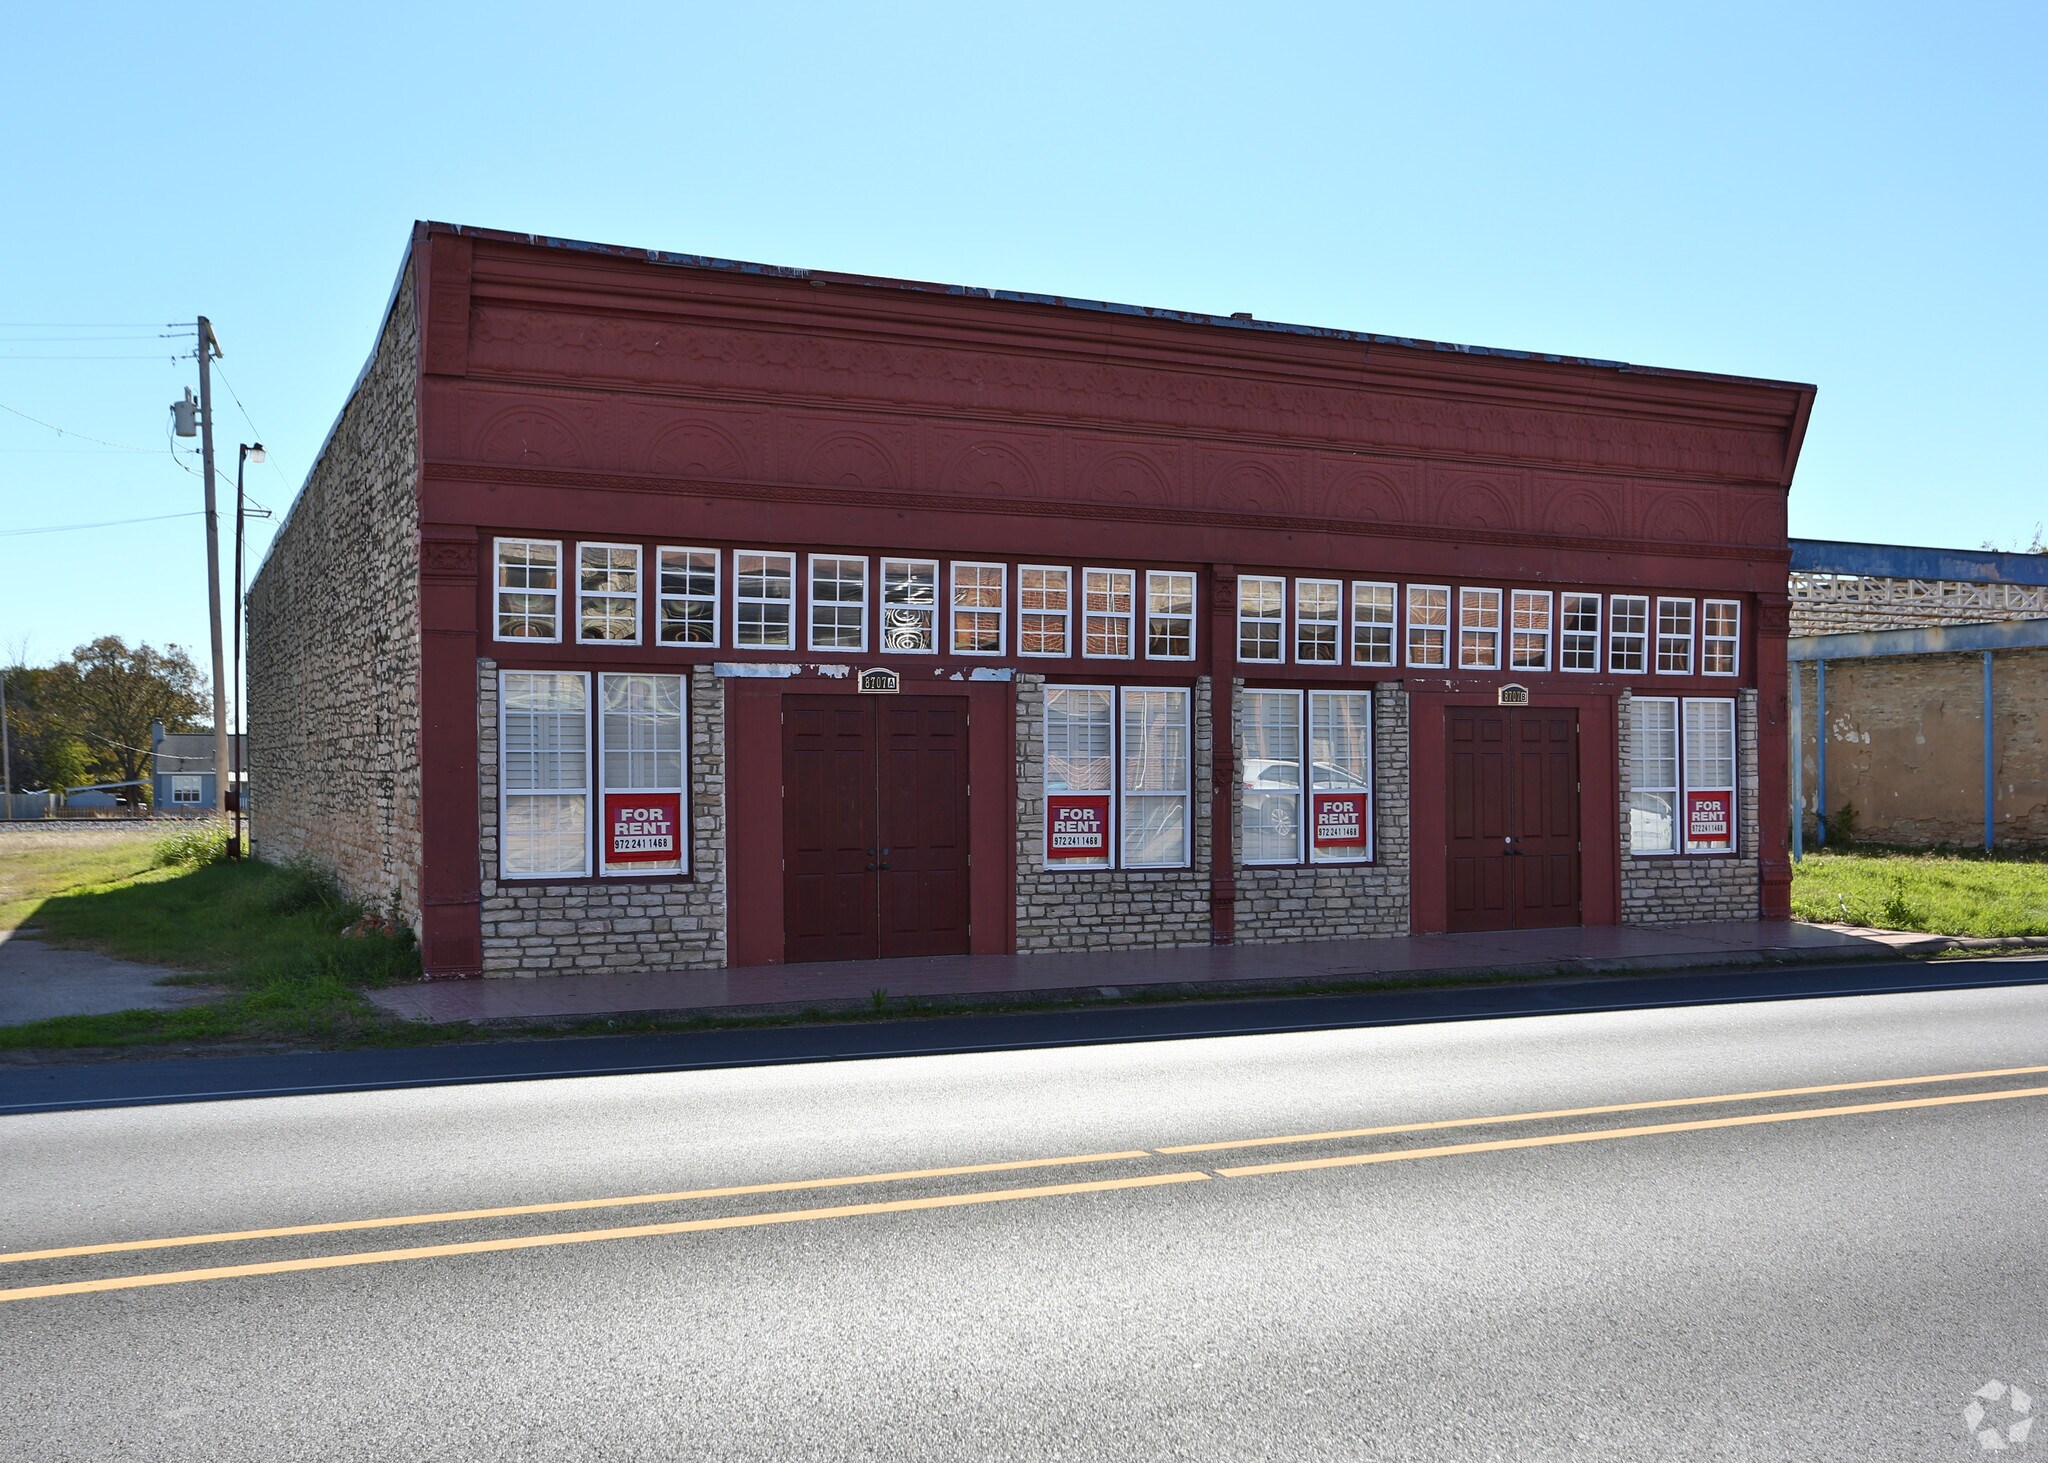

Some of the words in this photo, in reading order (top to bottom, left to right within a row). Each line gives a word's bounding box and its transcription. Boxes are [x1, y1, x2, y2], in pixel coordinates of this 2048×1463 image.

[1323, 801, 1354, 813] FOR
[1695, 801, 1721, 811] FOR
[621, 808, 663, 821] FOR
[1060, 808, 1095, 820] FOR
[1318, 813, 1359, 824] RENT
[1691, 811, 1726, 821] RENT
[614, 822, 671, 835] RENT
[1054, 821, 1101, 832] RENT
[615, 839, 630, 849] 972
[631, 839, 646, 849] 241
[648, 838, 668, 848] 1468
[1054, 836, 1067, 846] 972
[1068, 836, 1080, 845] 241
